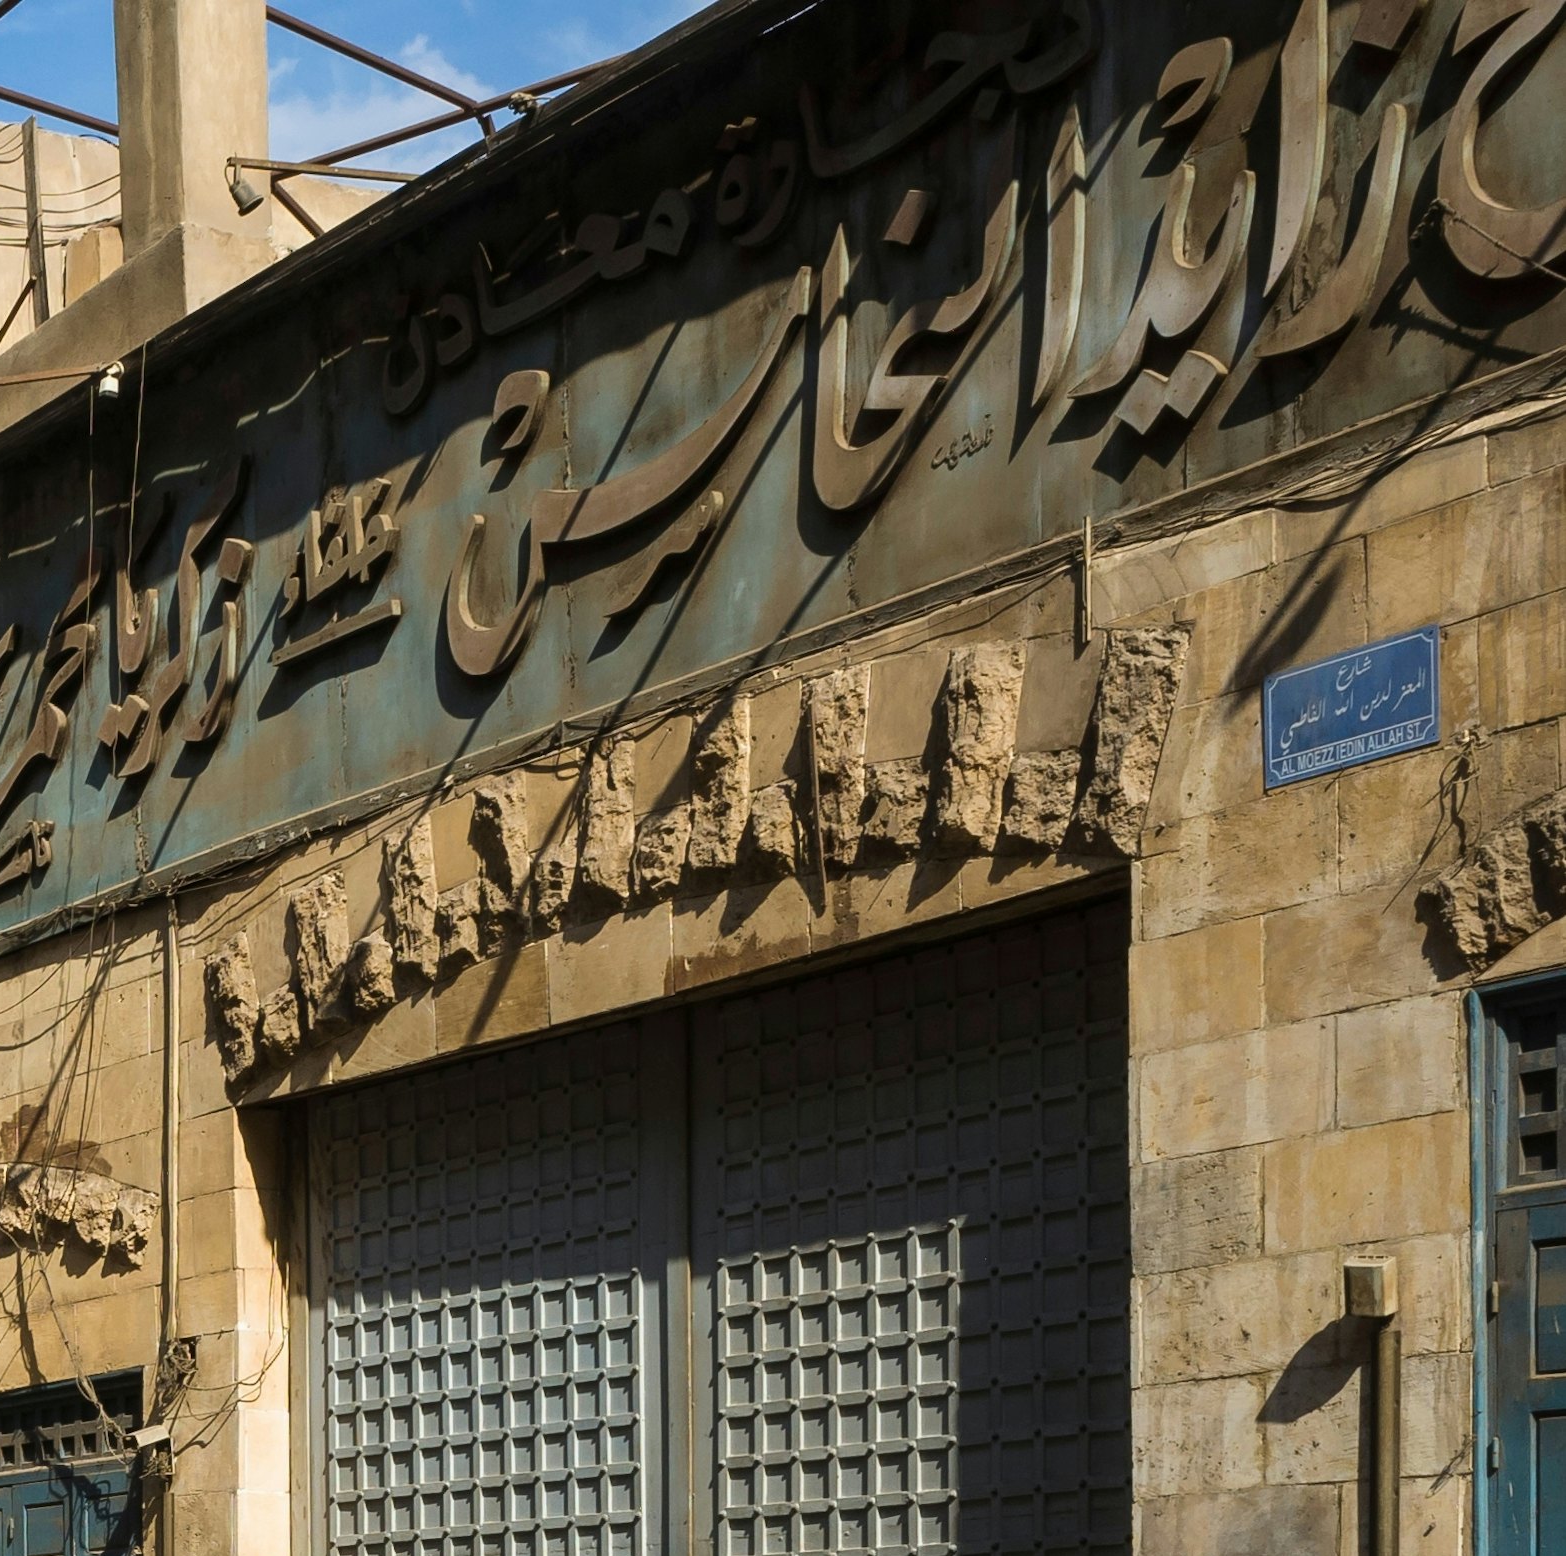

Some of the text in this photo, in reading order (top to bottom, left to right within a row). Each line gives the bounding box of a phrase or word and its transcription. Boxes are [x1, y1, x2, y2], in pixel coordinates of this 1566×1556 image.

[1336, 656, 1372, 691] شارع
[1280, 666, 1426, 755] المعز لدين الله الفاطمي
[1281, 758, 1296, 776] AL
[1297, 746, 1335, 772] MOEZZ
[1367, 726, 1404, 752] ALLAH
